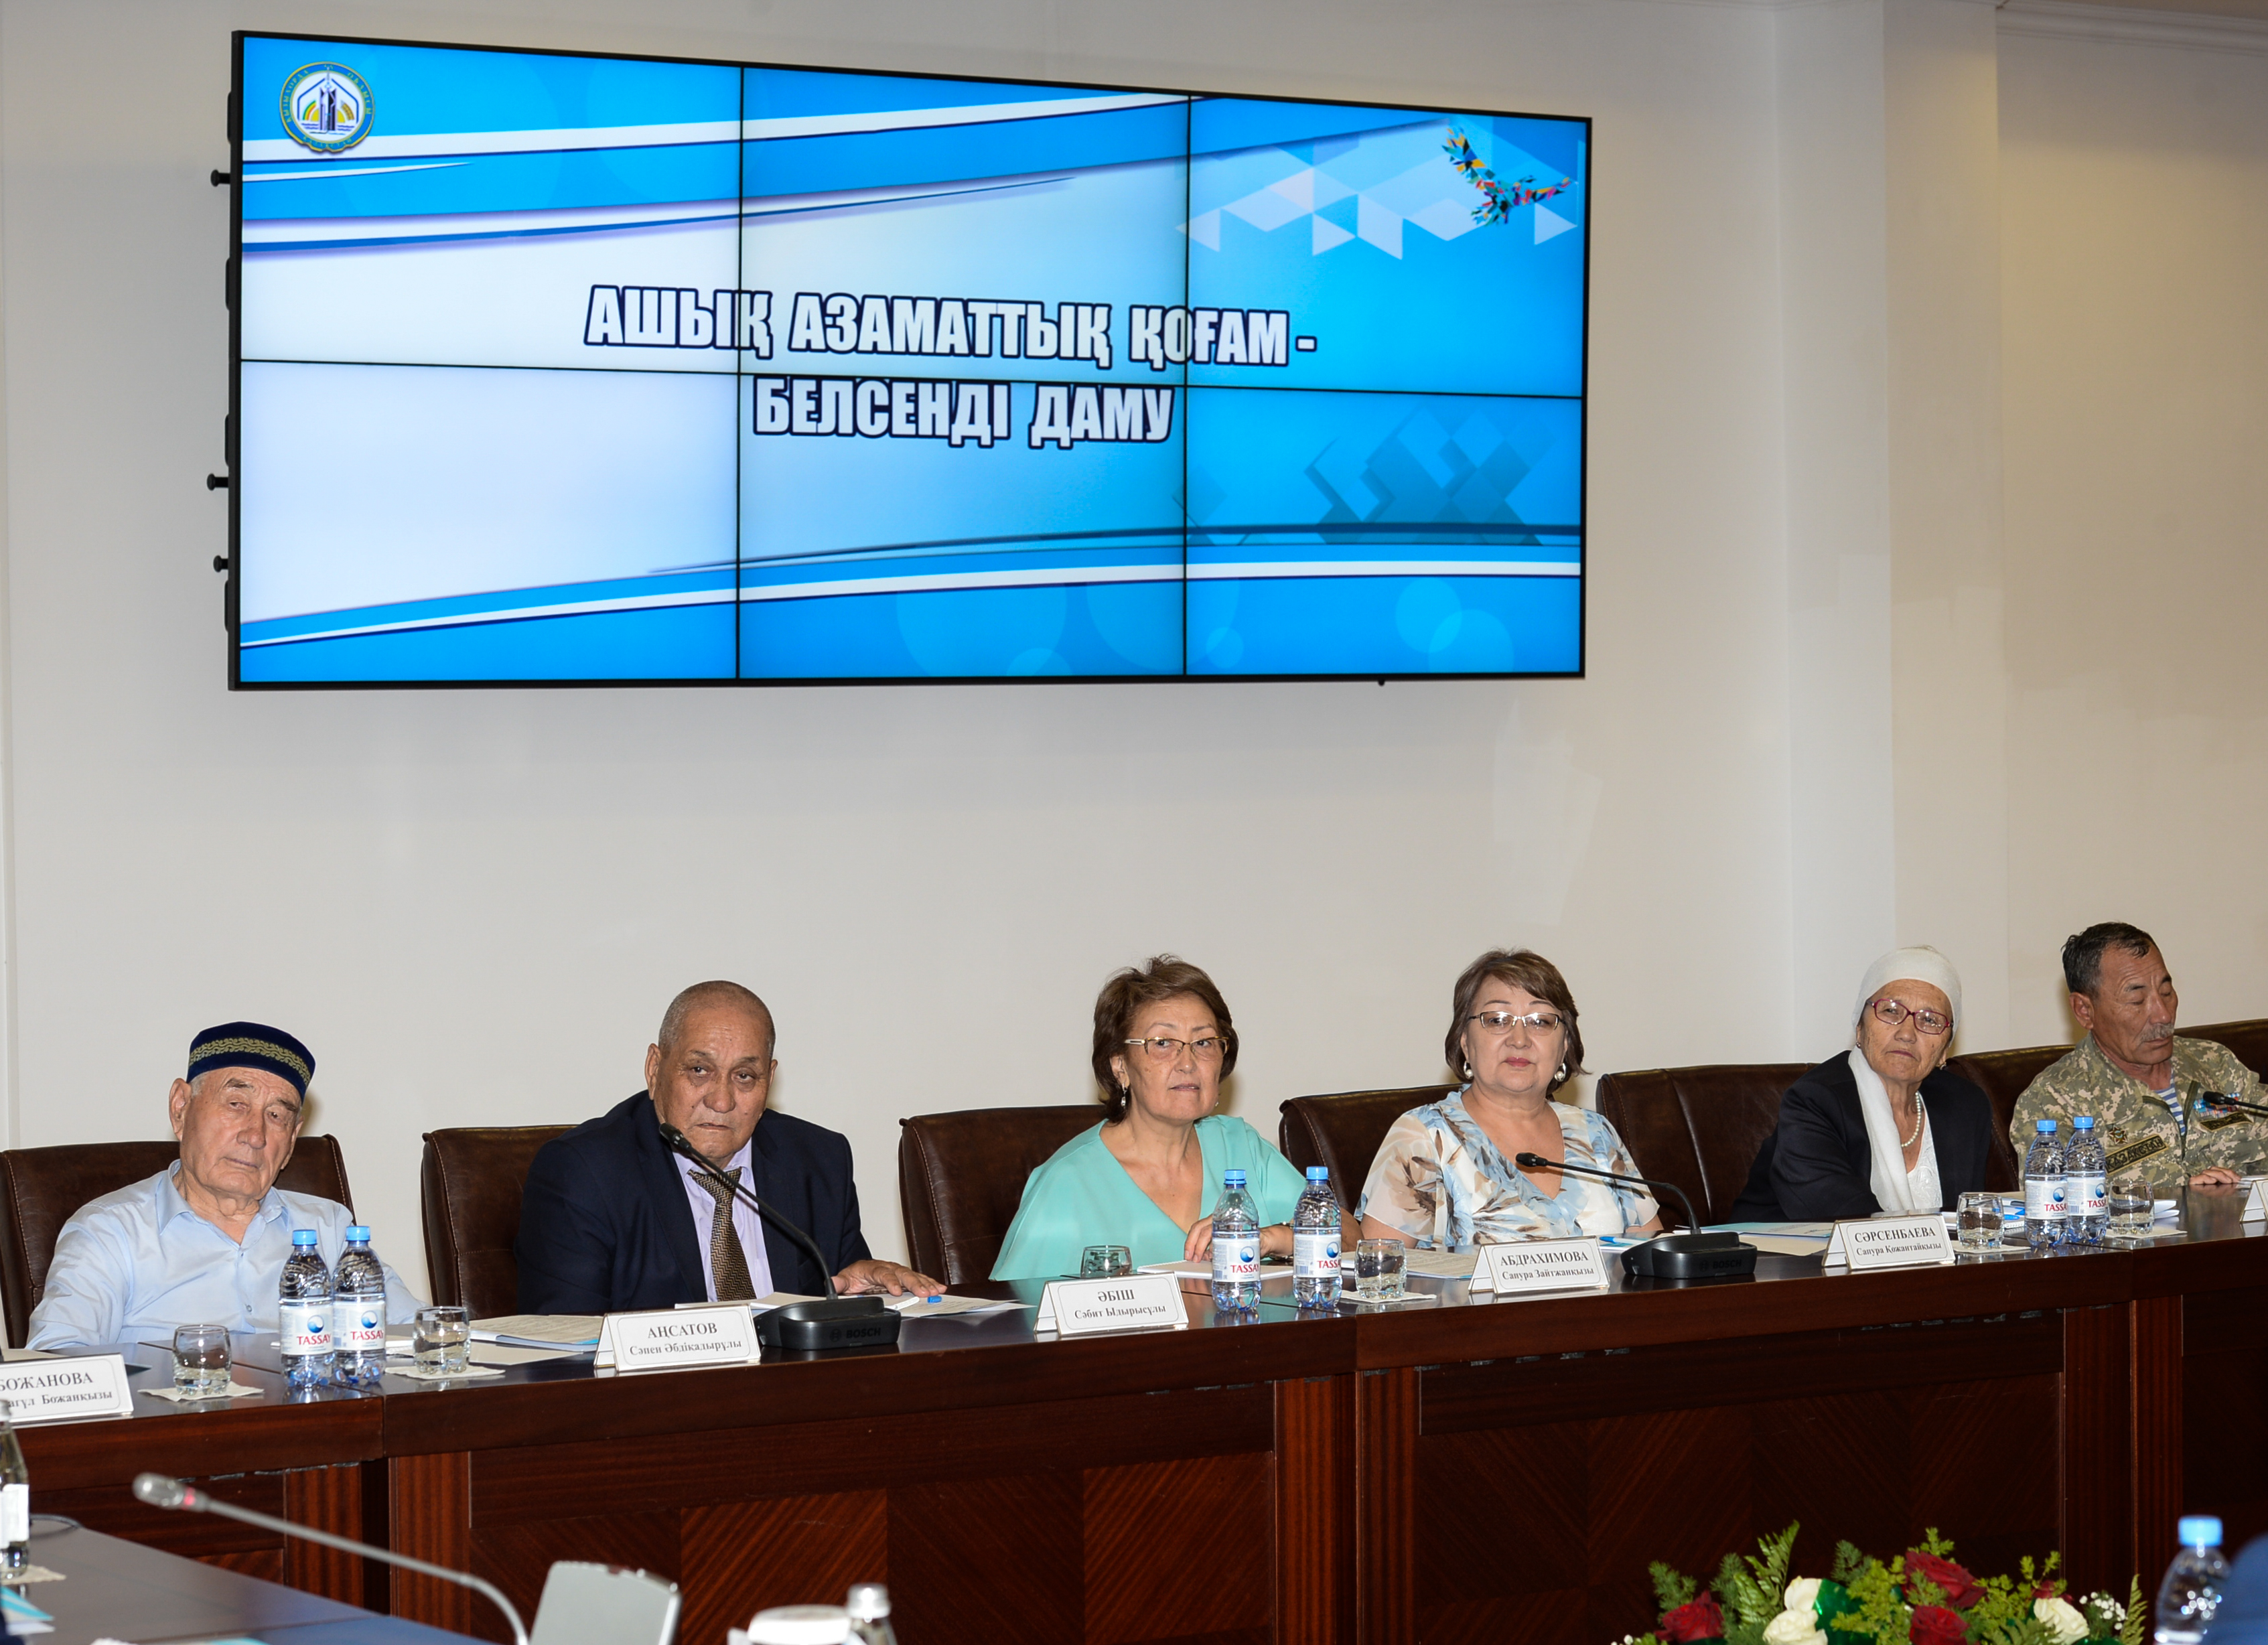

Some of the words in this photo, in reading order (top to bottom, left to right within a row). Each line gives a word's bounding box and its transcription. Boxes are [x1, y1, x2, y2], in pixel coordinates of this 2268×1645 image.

[585, 285, 773, 360] АШЫҚ
[787, 293, 1113, 369] АЗАМАТТЫҚ
[1129, 305, 1290, 371] ҚОҒАМ
[754, 376, 1011, 448] БЕЛСЕНДІ
[1028, 383, 1174, 451] ДАМУ
[2044, 1203, 2068, 1211] TASSA
[1855, 1227, 1936, 1242] СӘРСЕНБАЕВА
[1856, 1247, 1884, 1256] Сапура
[1316, 1259, 1342, 1269] TASSA
[1500, 1251, 1589, 1267] АБДРАХИМОВА
[1502, 1271, 1534, 1281] Сапура
[1097, 1289, 1135, 1302] ӘБІШ
[1074, 1309, 1103, 1319] Сәбит
[350, 1330, 384, 1340] TASSAY
[648, 1322, 717, 1338] АҢСАТОВ
[846, 1328, 881, 1338] BOSCH
[297, 1333, 332, 1345] TASSAY
[630, 1346, 662, 1356] Сәпен
